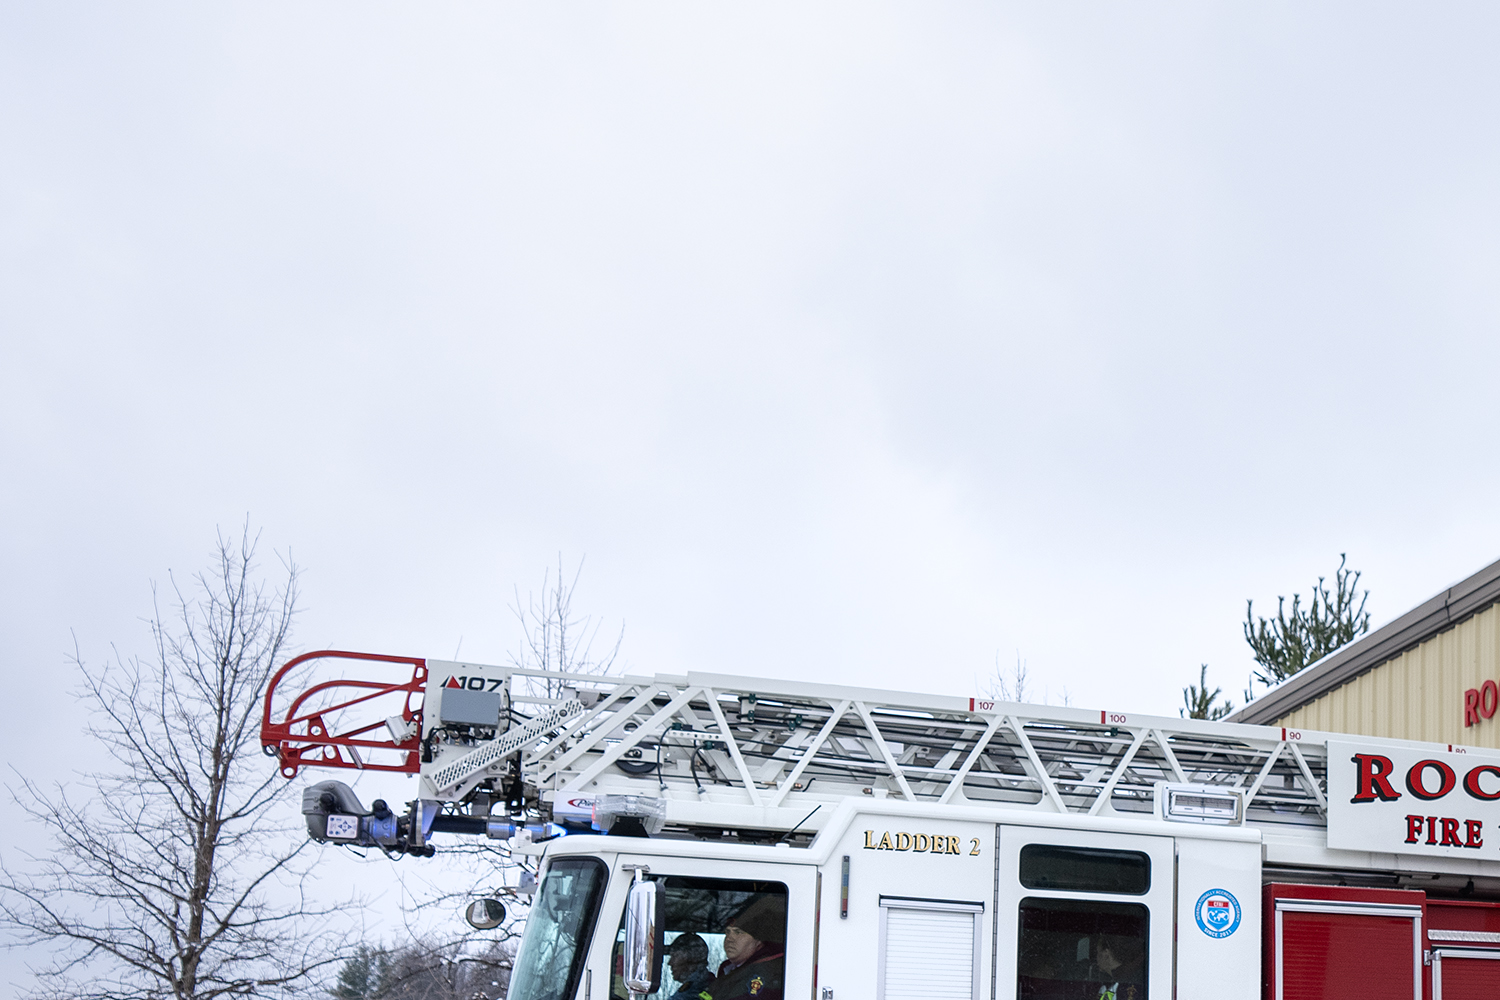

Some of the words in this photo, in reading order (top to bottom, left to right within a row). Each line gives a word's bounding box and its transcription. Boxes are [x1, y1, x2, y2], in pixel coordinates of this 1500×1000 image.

[978, 701, 995, 711] 107
[1109, 714, 1126, 724] 100
[1289, 731, 1301, 740] 90
[1404, 815, 1483, 849] FIRE
[863, 829, 961, 855] LADDER
[969, 837, 981, 856] 2
[1204, 928, 1218, 937] SINCE
